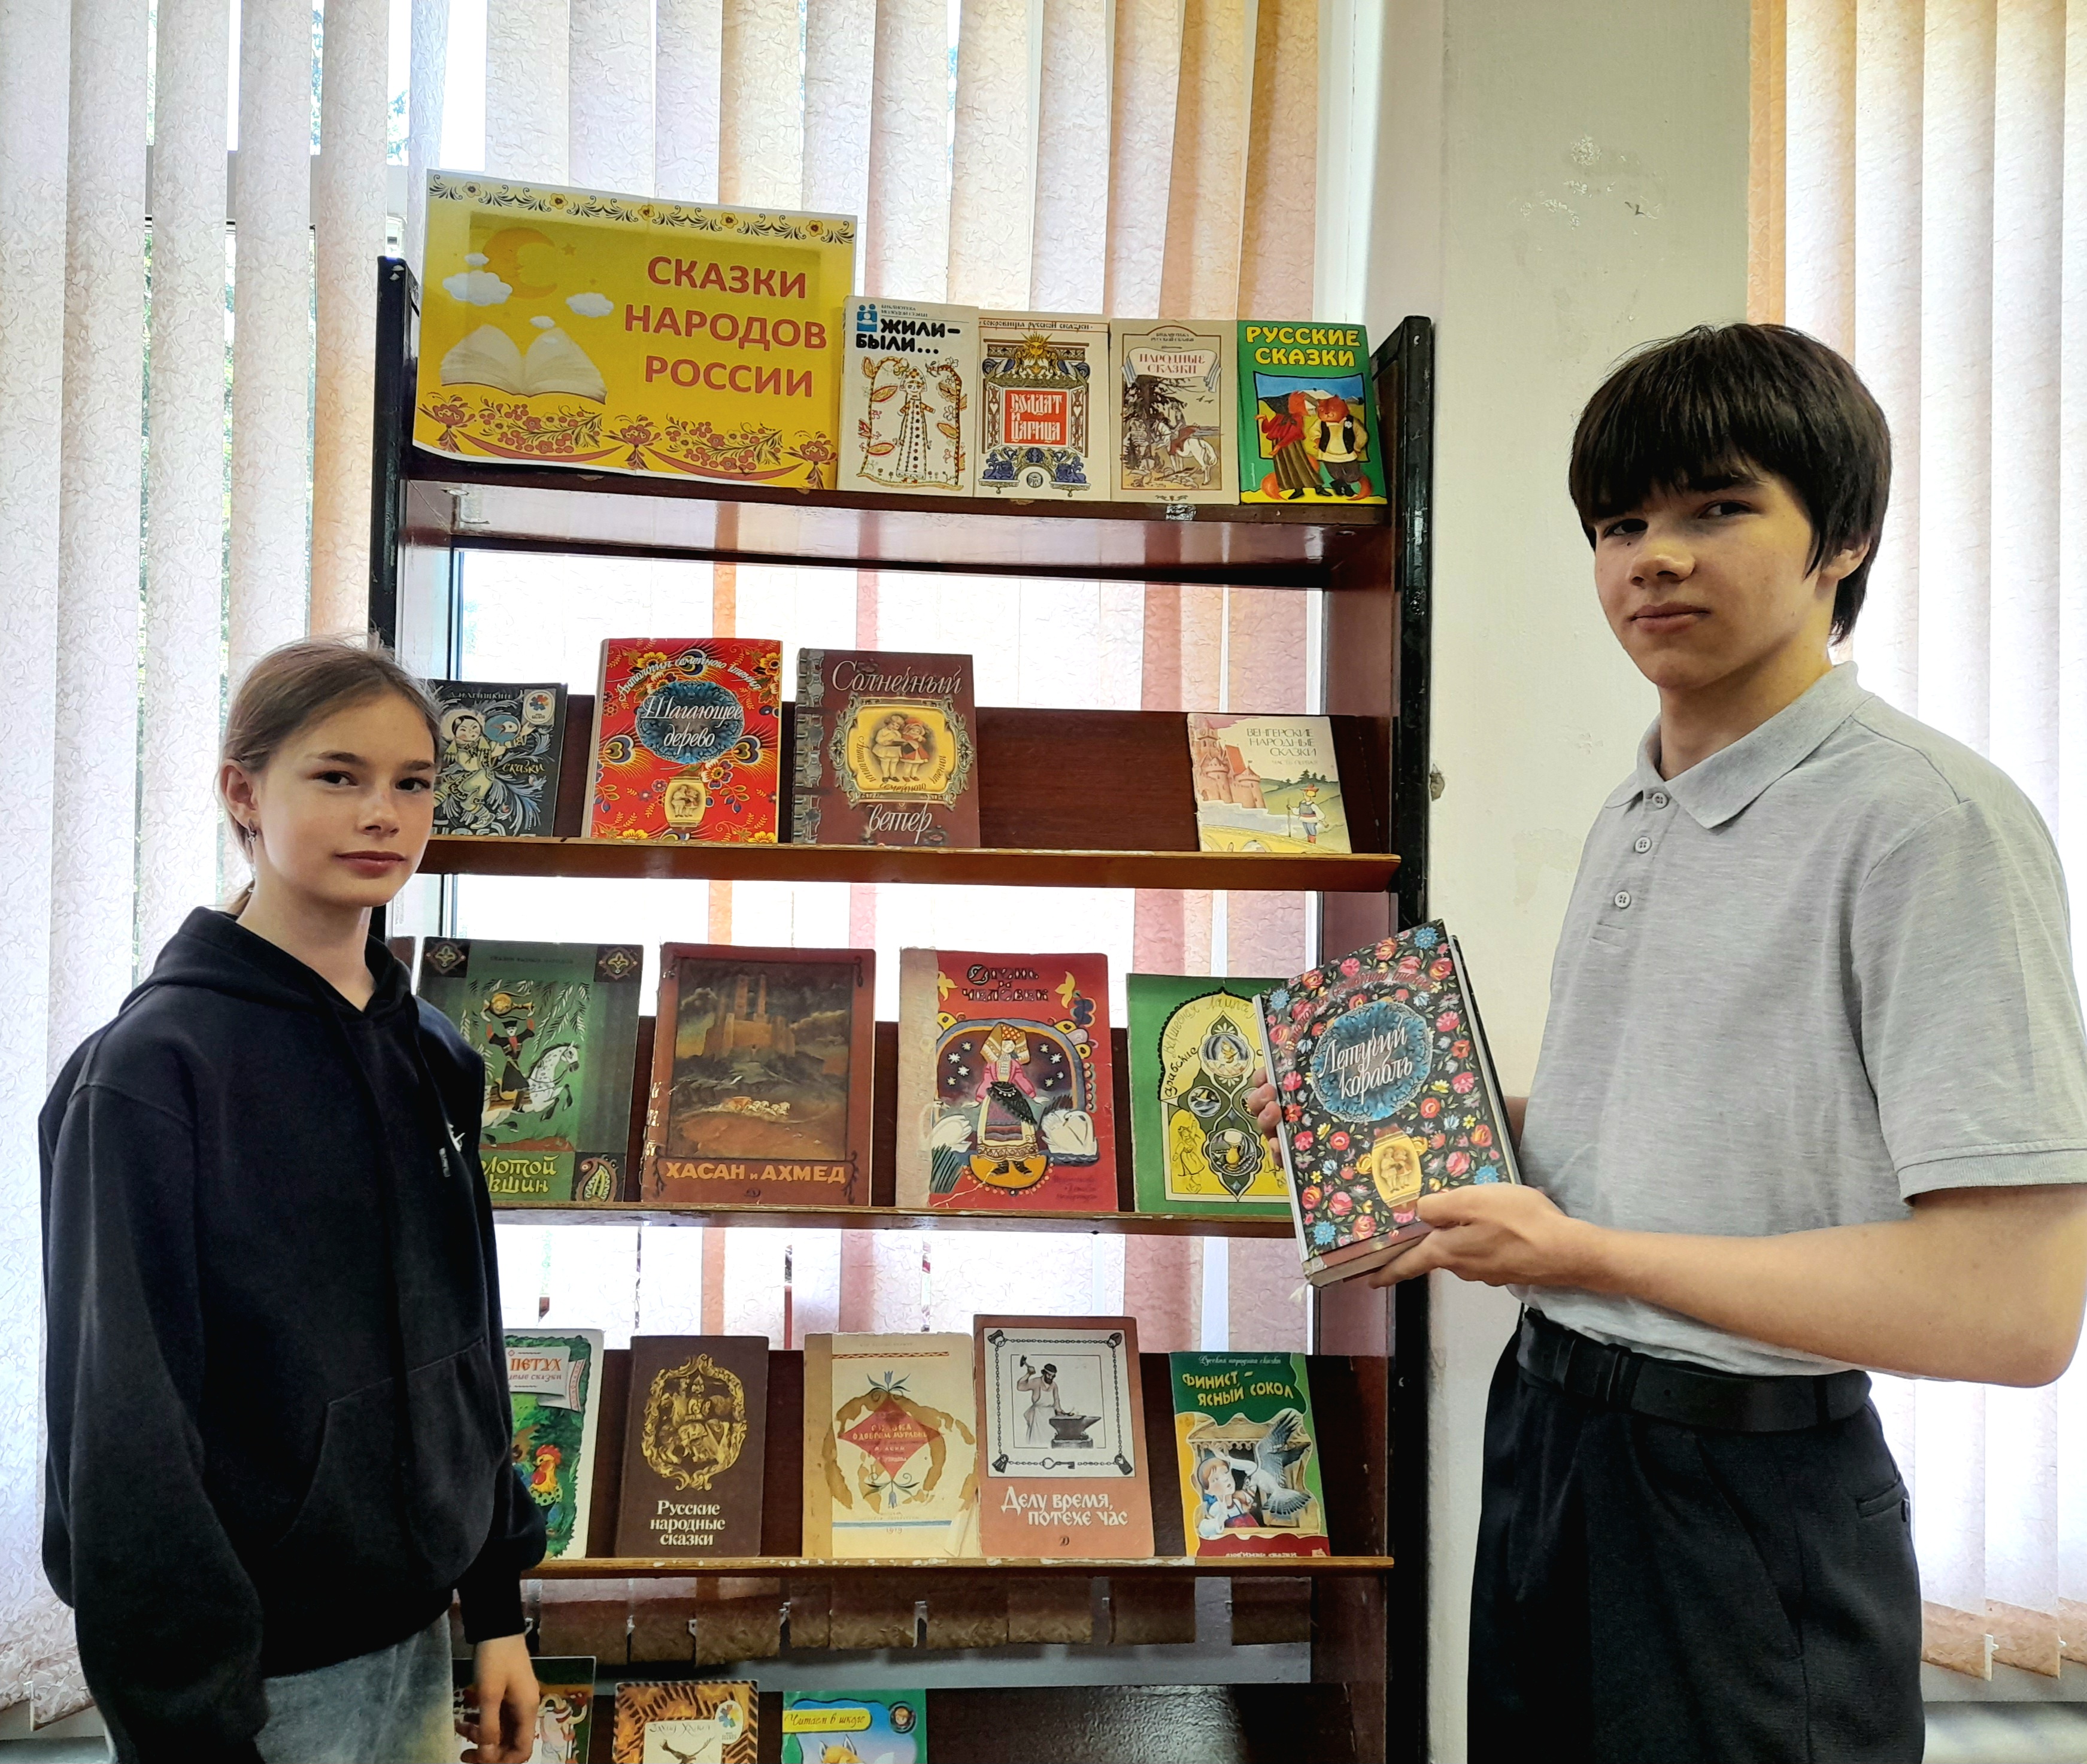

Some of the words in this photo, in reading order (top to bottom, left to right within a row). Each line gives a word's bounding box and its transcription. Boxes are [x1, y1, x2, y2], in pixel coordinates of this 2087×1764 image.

[647, 255, 806, 299] СКАЗКИ
[624, 303, 827, 351] НАРОДОВ
[1246, 326, 1361, 347] РУССКИЕ
[856, 333, 939, 354] БЫЛИ...
[1139, 353, 1206, 365] НАРОДНЫЕ
[1254, 347, 1355, 367] СКАЗКИ
[644, 354, 812, 397] РОССИИ
[1147, 364, 1197, 374] СКАЗКИ
[1010, 393, 1063, 416] СОЛДАТ
[1011, 420, 1061, 443] ЦАРИЦА
[617, 660, 673, 703] Антология
[674, 653, 727, 669] семейного
[727, 664, 763, 691] чтения
[832, 660, 963, 695] Солнечный
[640, 695, 745, 728] Шагающее
[663, 722, 715, 755] дерево
[1246, 728, 1315, 737] ВЕНГЕРСКИЕ
[1249, 737, 1315, 747] НАРОДНЫЕ
[856, 735, 877, 782] Антология
[1270, 747, 1316, 757] СКАЗКИ
[502, 760, 545, 776] сказки
[869, 797, 933, 845] ветер
[961, 988, 1049, 1002] ЧЕЛОВЕК
[1318, 1015, 1408, 1078] Летучий
[1164, 1047, 1199, 1097] арабские
[1339, 1048, 1412, 1104] корабль
[481, 1154, 560, 1178] лотой
[666, 1161, 745, 1181] ХАСАН
[760, 1164, 846, 1184] АХМЕД
[489, 1173, 550, 1194] вшин
[510, 1358, 562, 1371] ПЕТУХ
[1182, 1370, 1238, 1390] ФИНИСТ
[1197, 1383, 1245, 1407] ЯСНЫЙ
[1250, 1381, 1294, 1399] СОКОЛ
[656, 1500, 720, 1516] Русские
[1000, 1485, 1048, 1515] Делу
[1051, 1493, 1114, 1513] время,
[650, 1517, 726, 1534] народные
[1028, 1510, 1093, 1526] потехе
[1096, 1510, 1129, 1526] час
[660, 1532, 714, 1546] сказки
[784, 1714, 827, 1726] Читаем
[839, 1716, 866, 1728] школе
